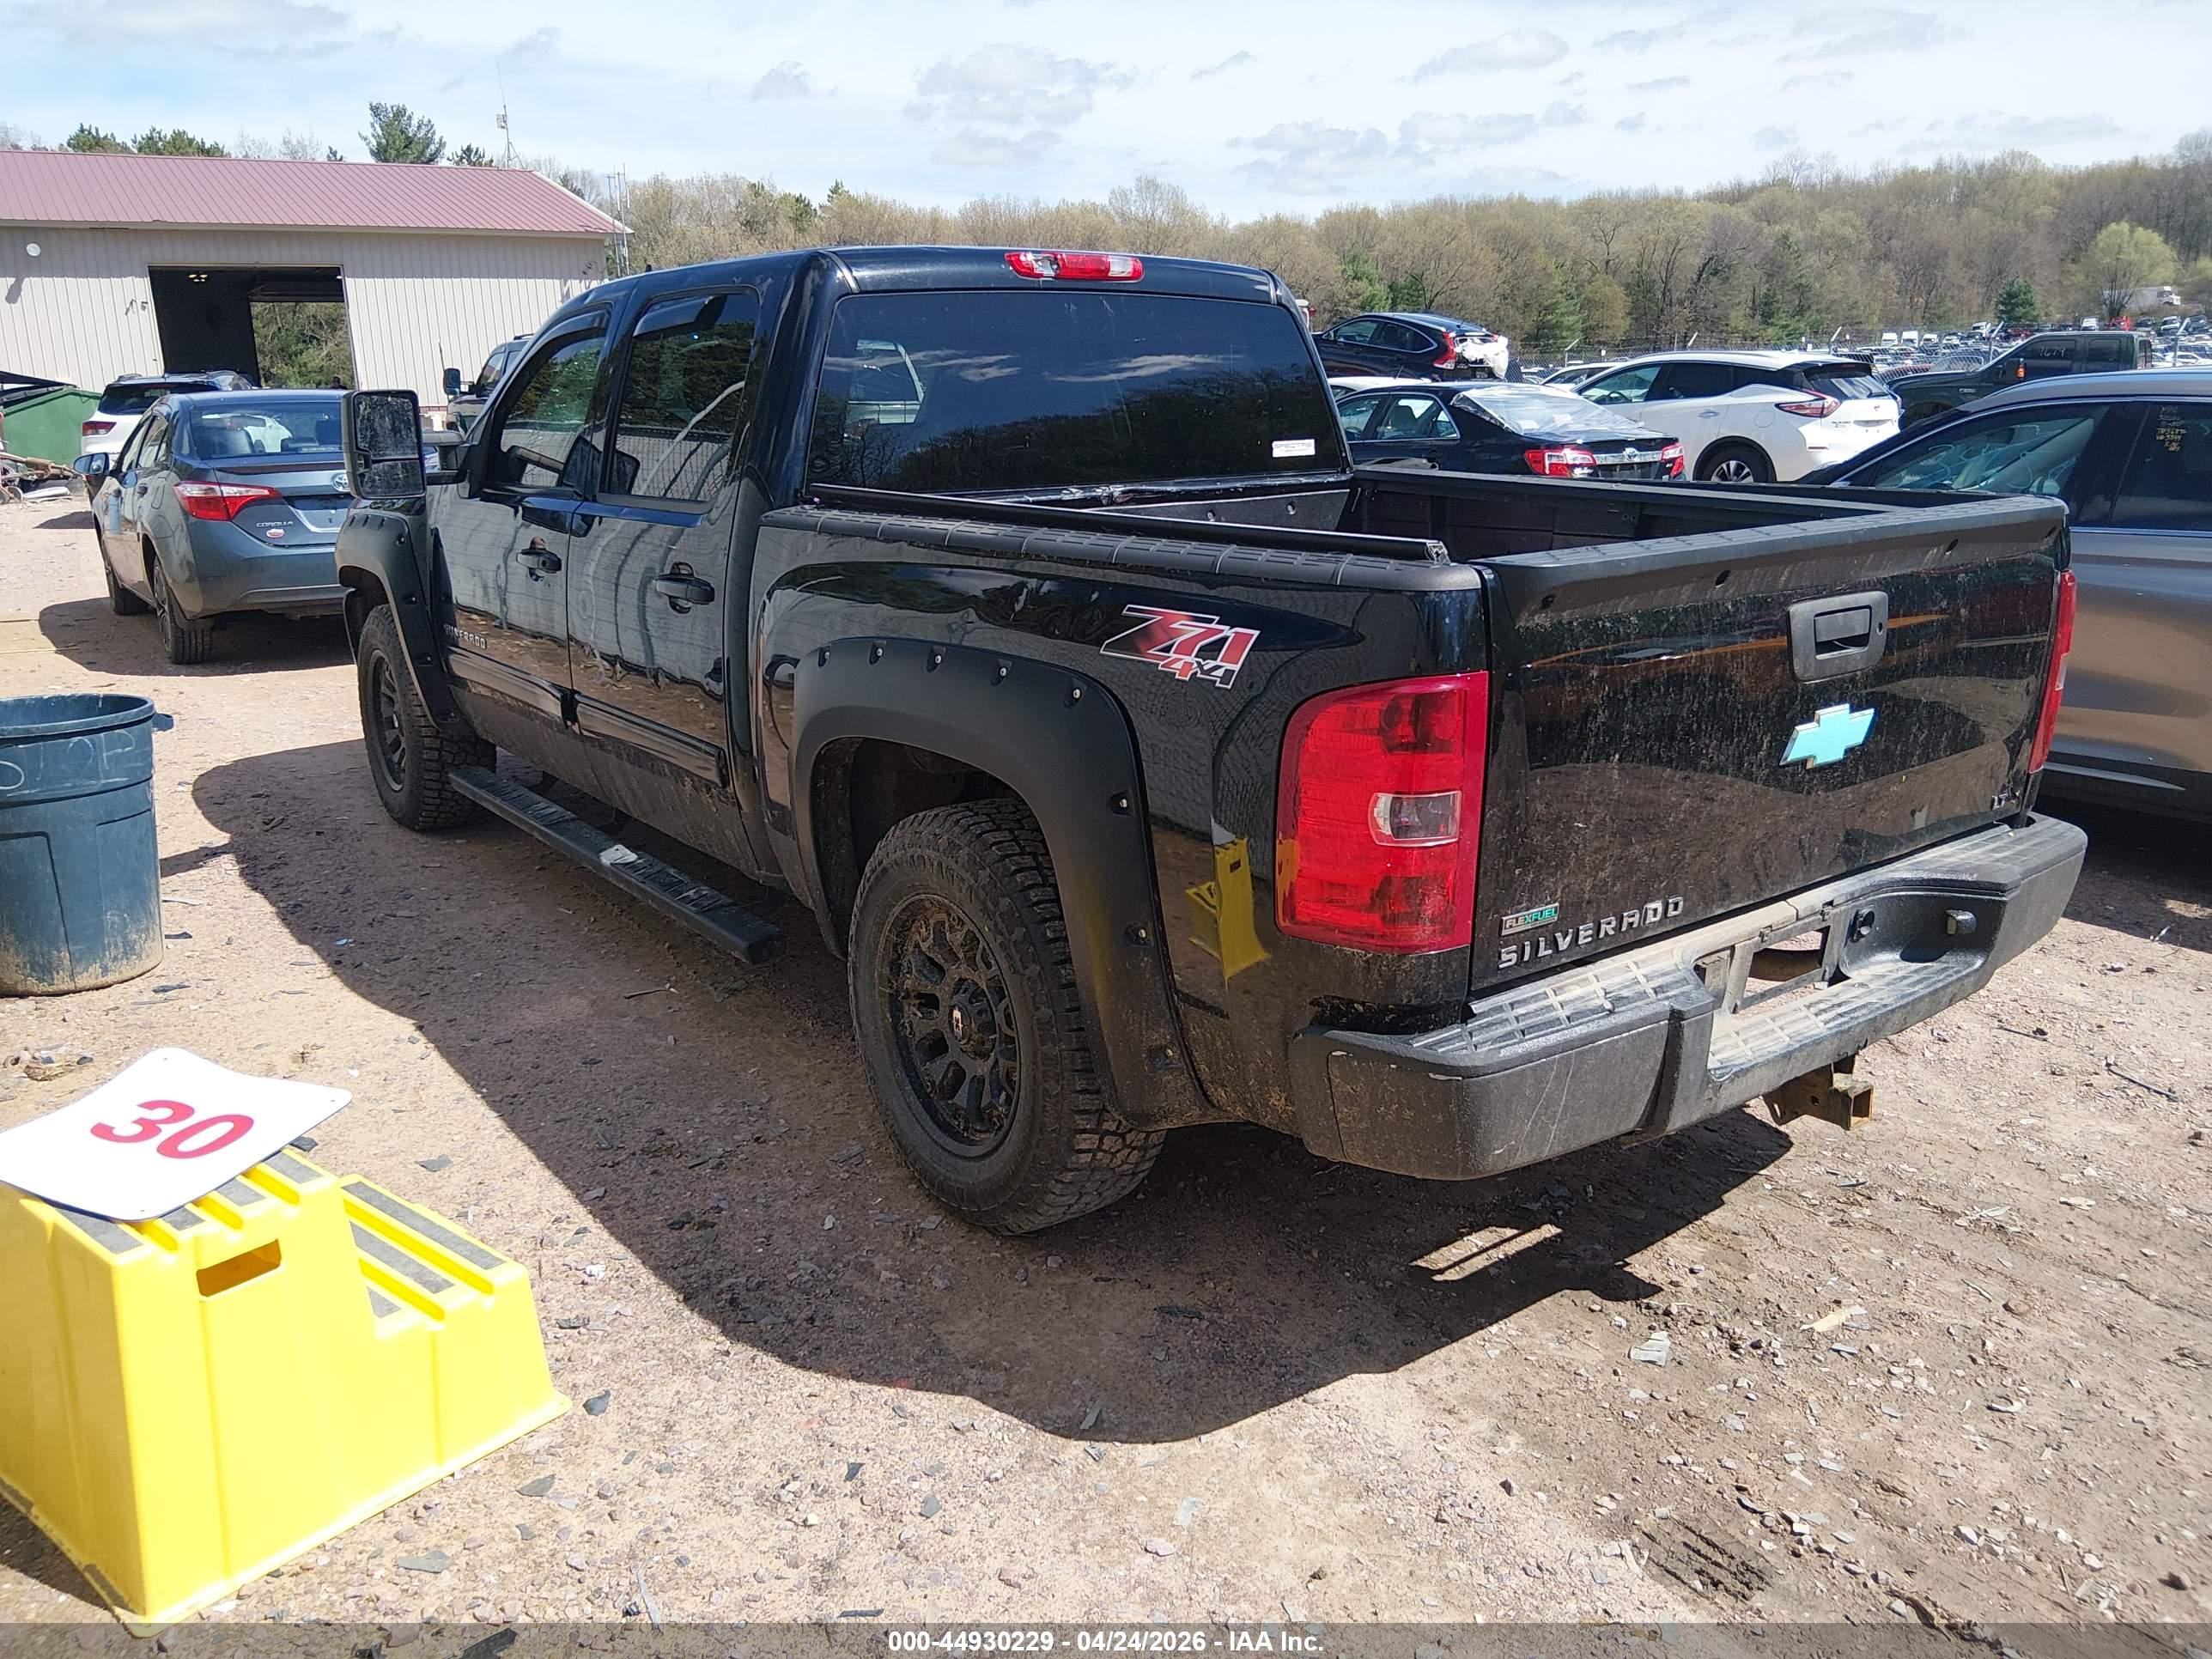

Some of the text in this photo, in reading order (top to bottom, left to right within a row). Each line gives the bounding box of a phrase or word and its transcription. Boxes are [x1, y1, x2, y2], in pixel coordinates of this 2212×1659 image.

[1100, 604, 1261, 670] Z71
[1498, 896, 1685, 970] SILVERADO
[90, 1099, 254, 1159] 30
